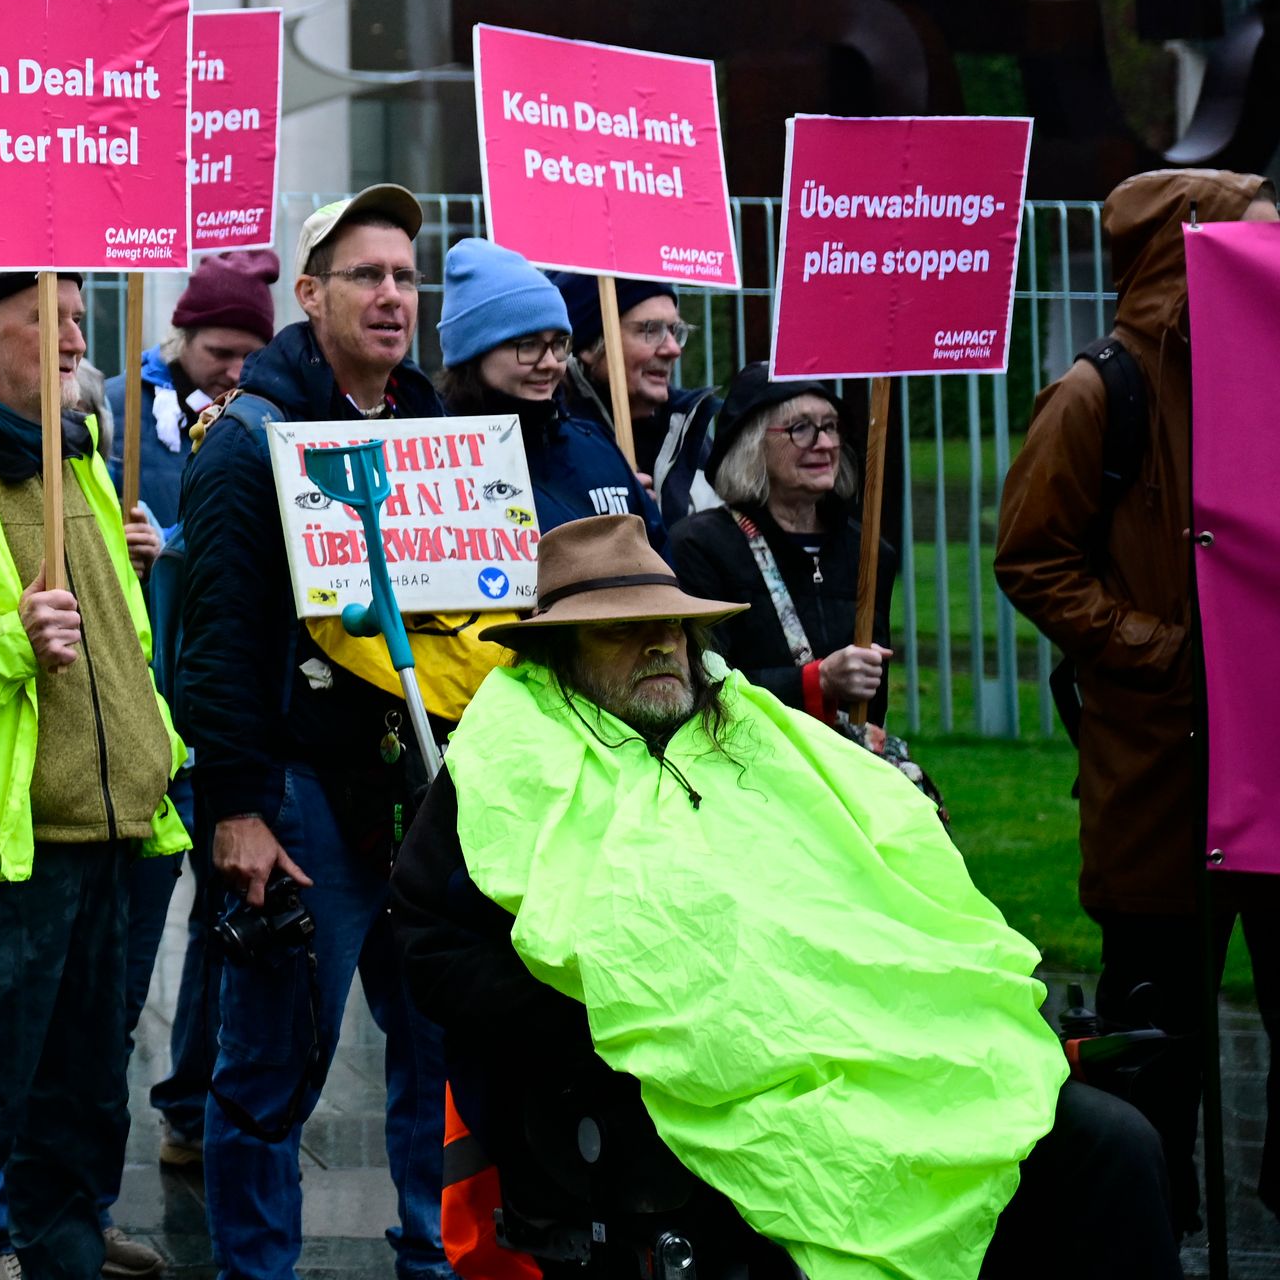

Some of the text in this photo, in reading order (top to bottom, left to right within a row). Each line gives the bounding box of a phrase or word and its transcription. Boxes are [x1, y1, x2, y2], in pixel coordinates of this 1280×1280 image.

[19, 58, 93, 97] Deal
[103, 60, 160, 100] mit
[502, 90, 697, 148] Kein Deal mit
[56, 125, 139, 166] Thiel
[525, 148, 684, 199] Peter Thiel
[800, 180, 1005, 226] Überwachungs-
[196, 208, 264, 227] CAMPACT
[105, 228, 177, 246] CAMPACT
[196, 224, 259, 239] Bewegt Politik
[105, 245, 173, 261] Bewegt Politik
[660, 245, 724, 266] CAMPACT
[803, 242, 990, 282] pläne stoppen
[662, 260, 694, 276] Bewegt
[934, 330, 998, 346] CAMPACT
[933, 346, 991, 361] Bewegt Politik
[330, 573, 431, 589] IST MHBAR
